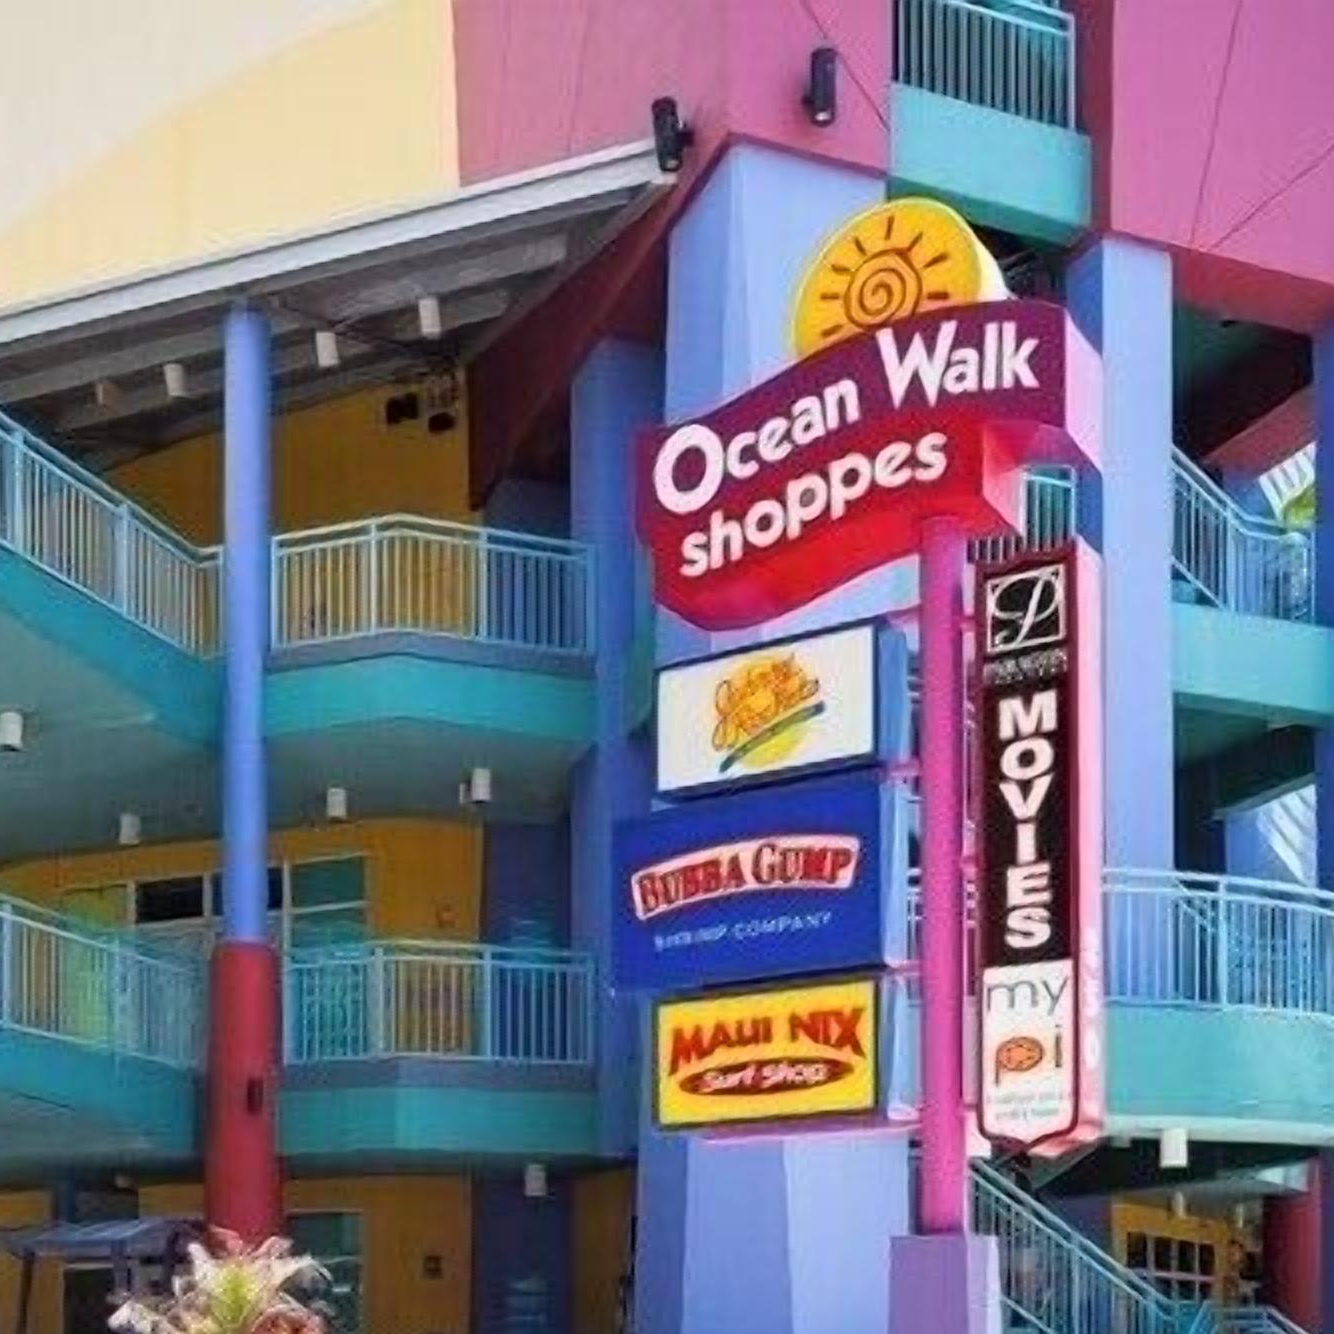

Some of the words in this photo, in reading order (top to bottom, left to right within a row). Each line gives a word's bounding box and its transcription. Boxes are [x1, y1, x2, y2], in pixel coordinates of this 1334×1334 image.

[653, 378, 860, 514] Ocean
[875, 320, 1040, 408] Walk
[679, 431, 948, 578] shoppes
[998, 689, 1059, 949] MOVIES
[639, 852, 748, 914] BUBBA
[751, 843, 853, 886] GUMP
[733, 911, 832, 940] COMPANY
[986, 976, 1069, 1017] my
[669, 1016, 773, 1076] MAUI
[789, 1007, 866, 1059] NIX
